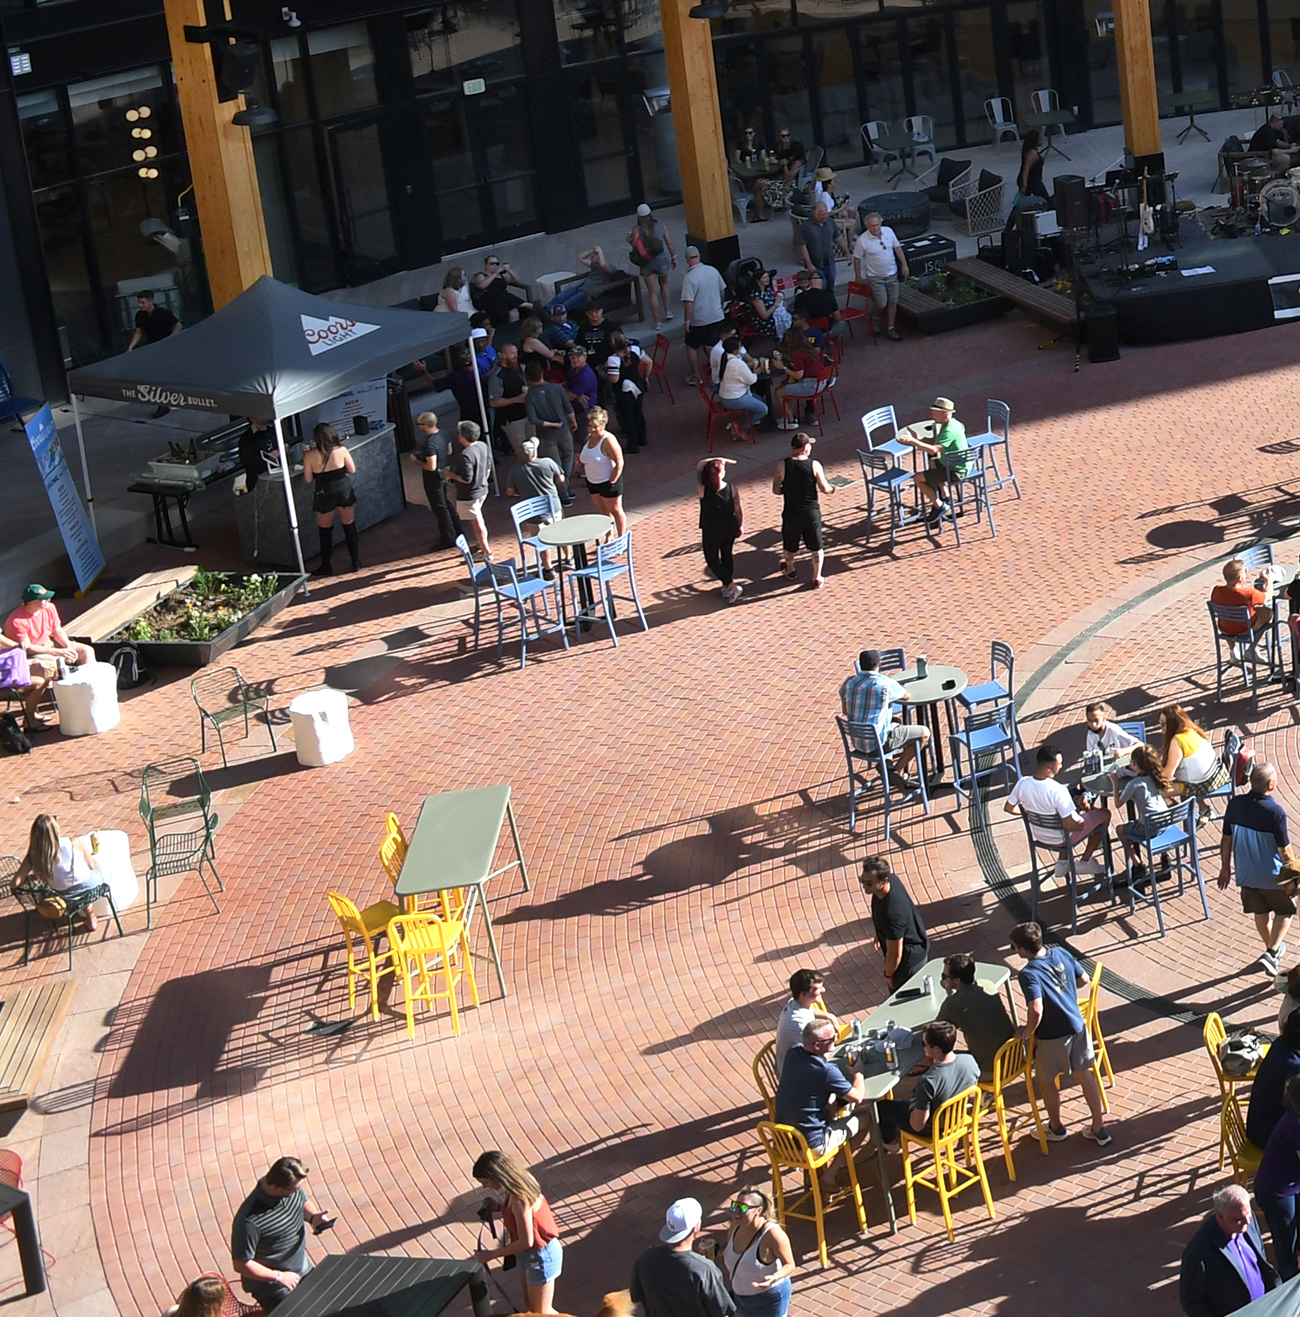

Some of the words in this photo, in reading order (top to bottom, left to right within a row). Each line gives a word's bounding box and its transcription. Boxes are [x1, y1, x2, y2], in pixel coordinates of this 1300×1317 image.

[303, 319, 357, 345] Coors
[322, 328, 358, 347] LIGHT
[122, 388, 136, 398] THE
[137, 383, 188, 406] Silver
